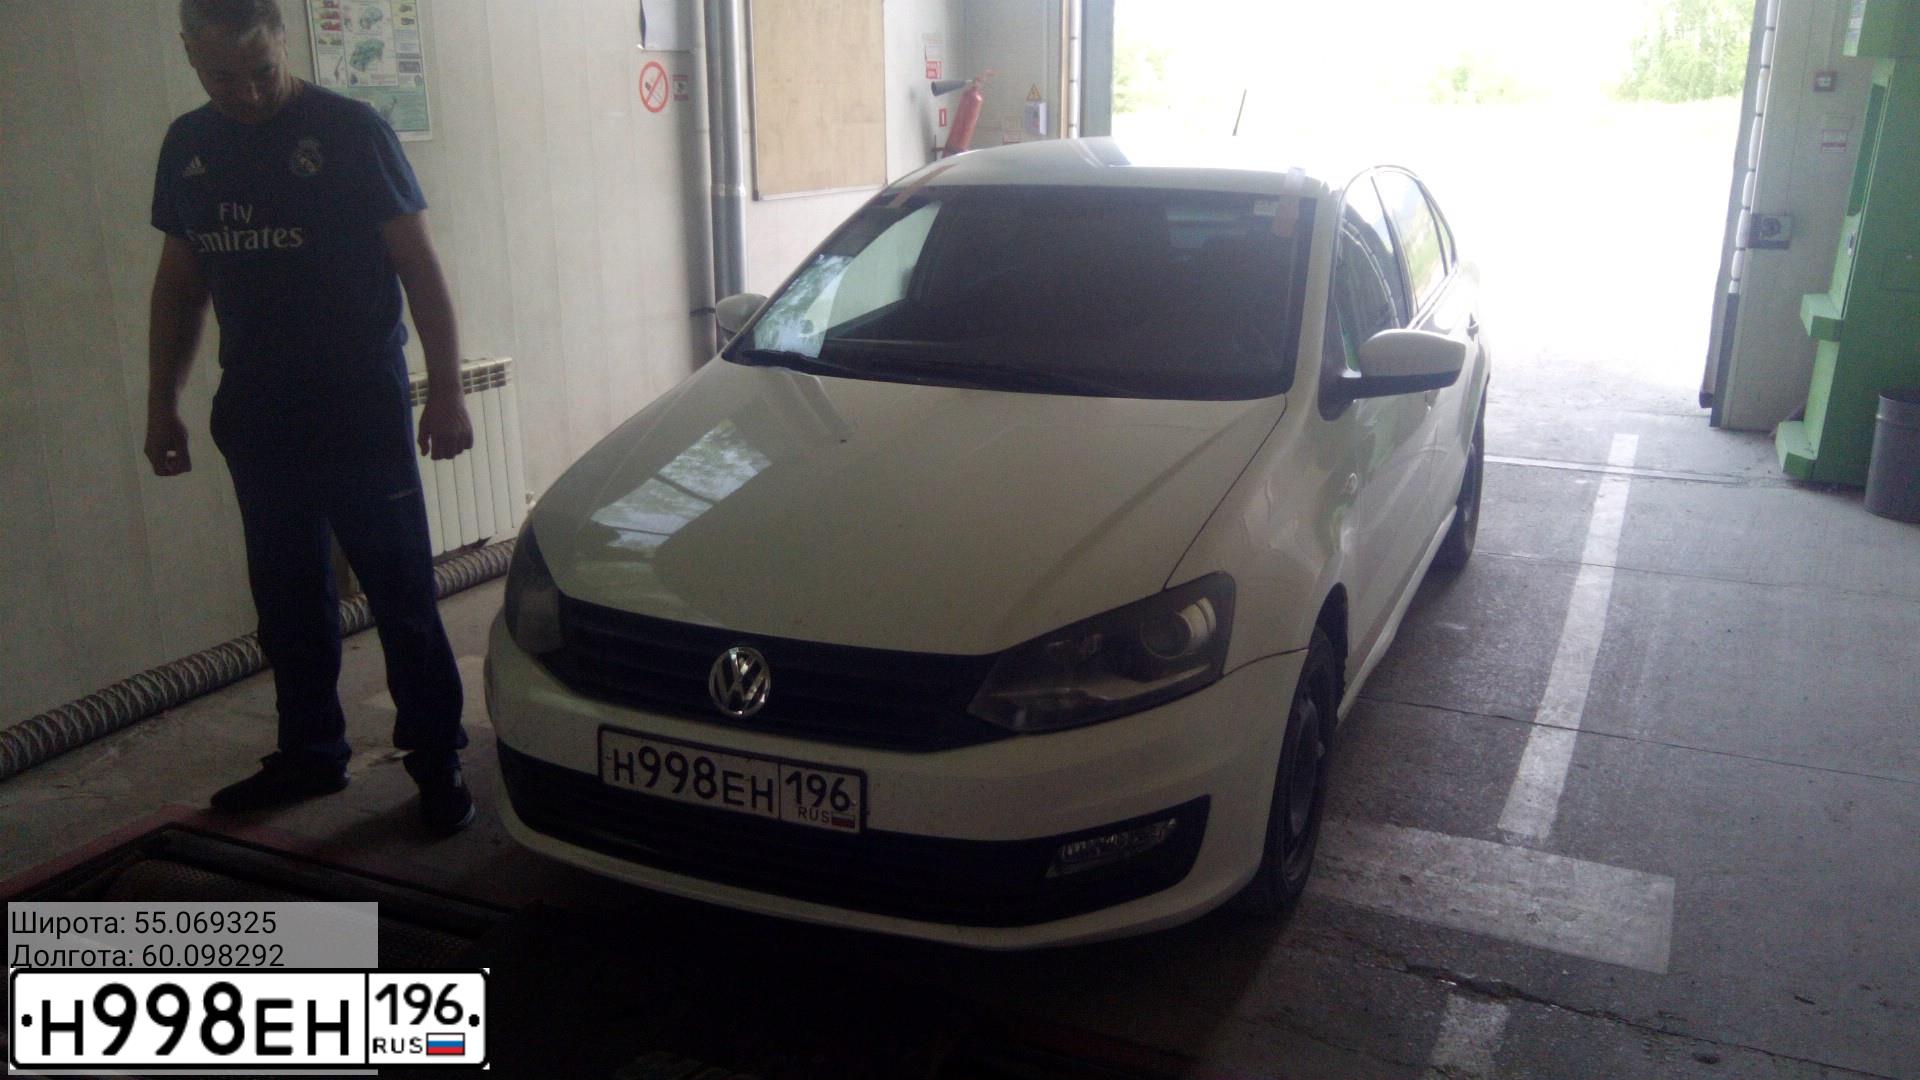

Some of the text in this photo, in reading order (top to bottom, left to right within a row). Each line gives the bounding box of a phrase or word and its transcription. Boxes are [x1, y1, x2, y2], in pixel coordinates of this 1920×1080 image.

[219, 202, 253, 223] Fly
[785, 771, 850, 812] 196
[797, 807, 831, 824] RUS
